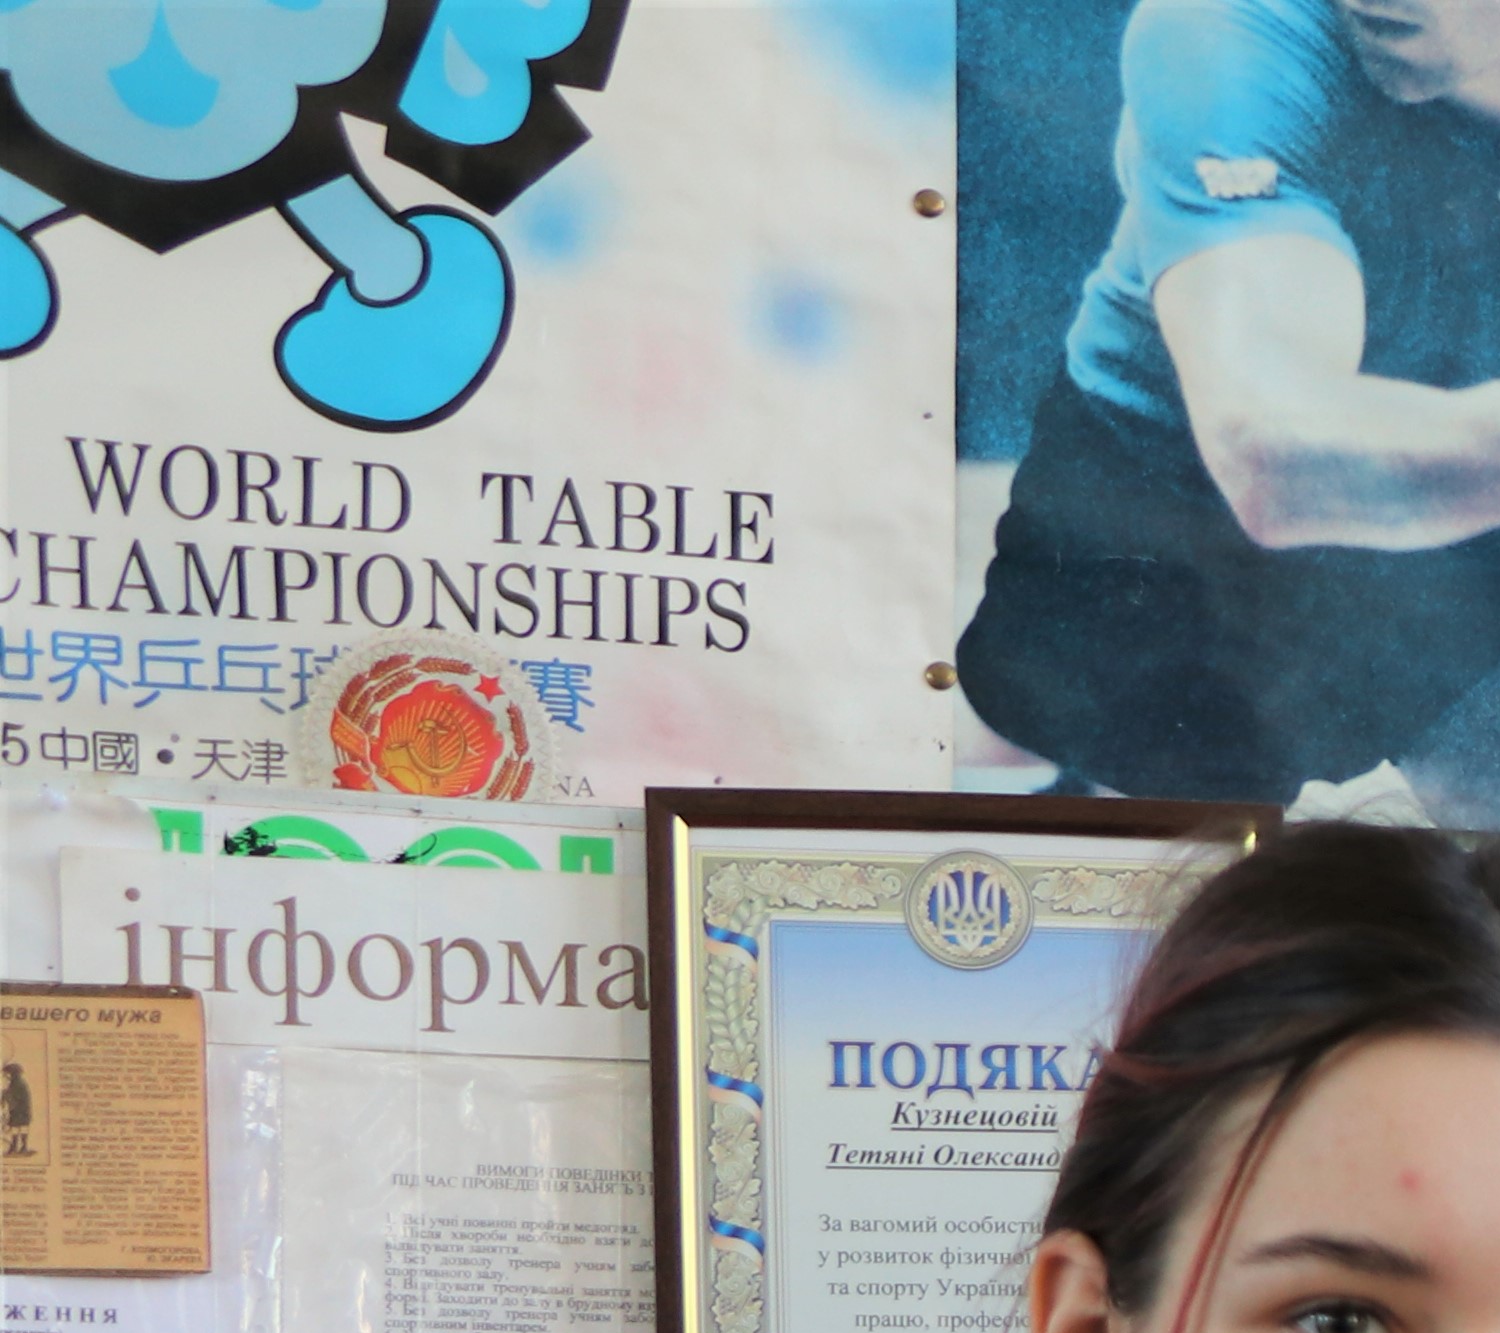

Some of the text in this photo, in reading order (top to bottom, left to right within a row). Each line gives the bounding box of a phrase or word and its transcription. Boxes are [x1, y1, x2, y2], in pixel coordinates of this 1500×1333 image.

[66, 437, 777, 565] WORLD TABLE
[97, 1006, 163, 1027] мужа
[890, 1101, 1058, 1130] Кузнецовій
[826, 1142, 926, 1168] Тетяні
[818, 1213, 938, 1234] За вагомий
[817, 1250, 829, 1269] у
[837, 1249, 934, 1272] розвиток
[827, 1279, 929, 1303] та спорту
[854, 1313, 930, 1333] працю,
